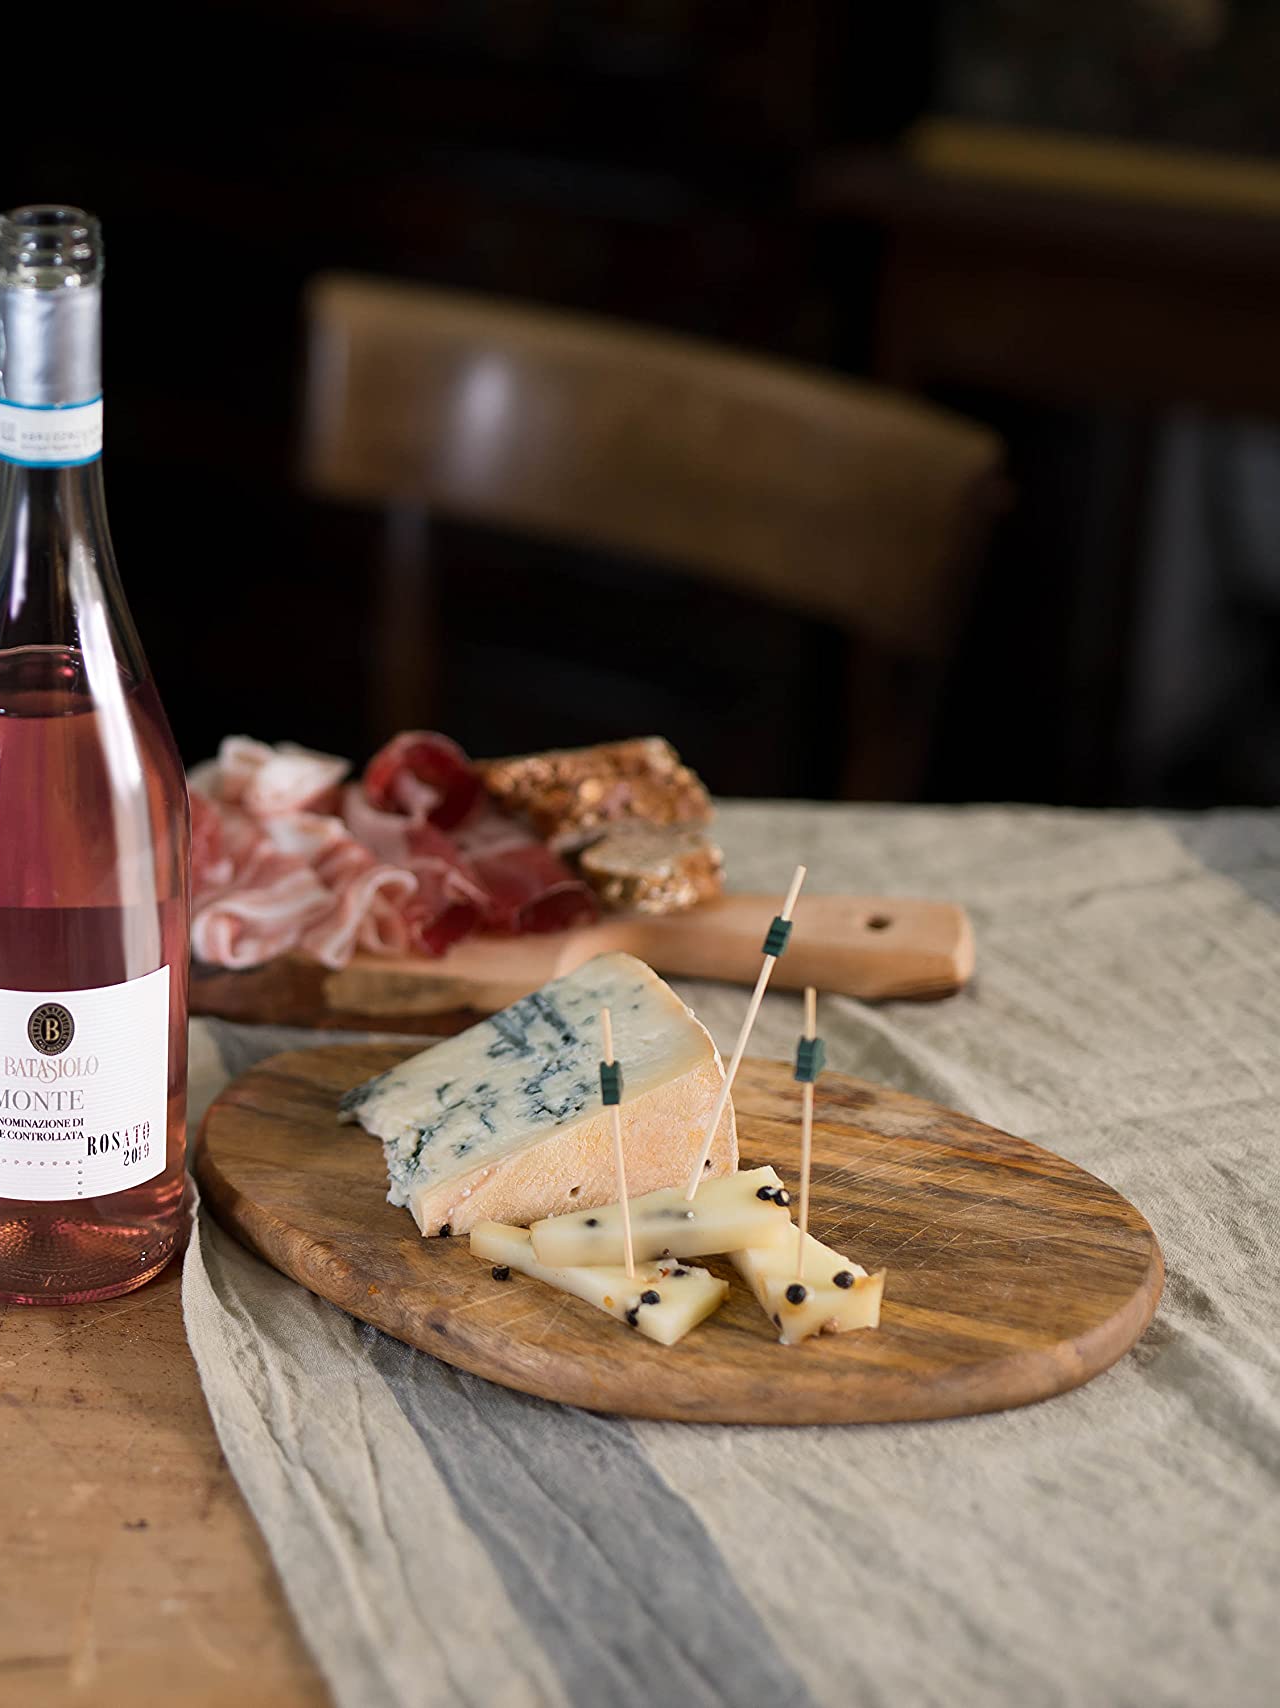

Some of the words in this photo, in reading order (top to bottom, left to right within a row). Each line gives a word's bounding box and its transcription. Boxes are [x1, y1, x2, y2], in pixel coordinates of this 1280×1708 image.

[45, 1018, 60, 1041] B
[4, 1055, 100, 1084] BATASIOLO
[72, 1117, 84, 1127] DI
[7, 1130, 85, 1142] CONTROLLATA
[86, 1120, 150, 1157] ROSATO
